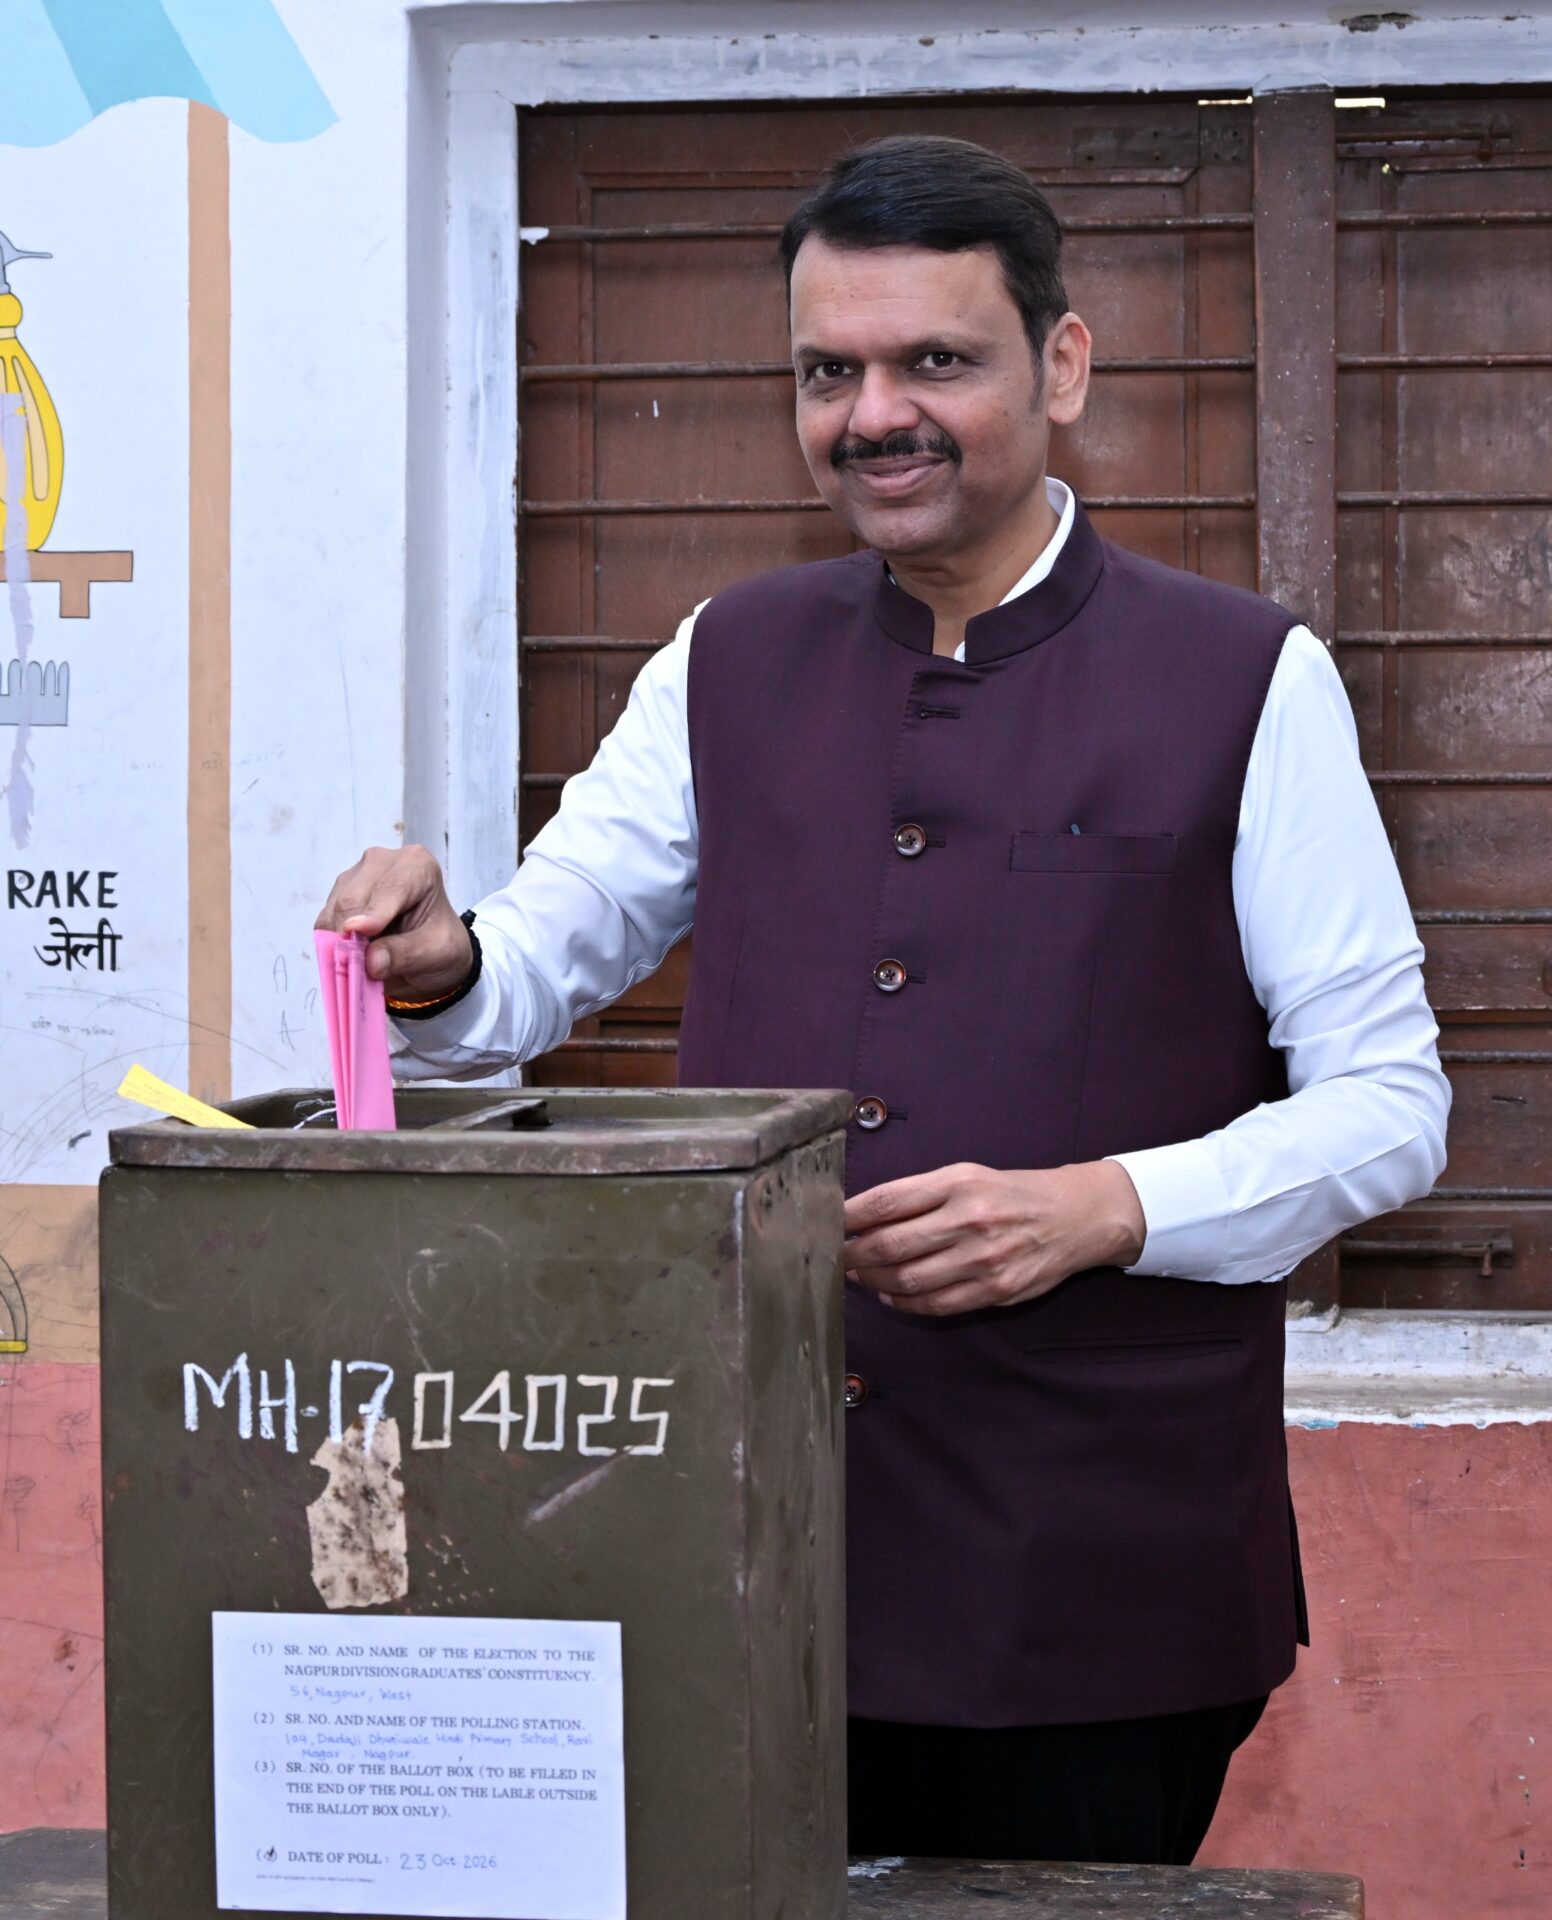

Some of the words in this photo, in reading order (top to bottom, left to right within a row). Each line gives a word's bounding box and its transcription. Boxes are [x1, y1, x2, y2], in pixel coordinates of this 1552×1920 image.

[7, 869, 119, 909] RAKE
[411, 1370, 675, 1456] 04025
[252, 1643, 273, 1656] (1)
[283, 1645, 303, 1656] SR.
[308, 1645, 330, 1657] NO.
[336, 1646, 364, 1657] AND
[369, 1646, 408, 1658] NAME
[418, 1647, 437, 1659] OF
[442, 1648, 468, 1659] THE
[473, 1649, 537, 1660] ELECTION
[543, 1649, 562, 1661] TO
[568, 1650, 595, 1661] THE
[253, 1712, 275, 1725] (2)
[285, 1713, 304, 1725] SR.
[308, 1714, 330, 1725] NO.
[334, 1715, 364, 1726] AND
[366, 1715, 406, 1727] NAME
[409, 1716, 427, 1727] OF
[430, 1717, 458, 1728] THE
[461, 1717, 519, 1729] POLLING
[522, 1719, 585, 1731] STATION.
[255, 1761, 276, 1774] (3)
[286, 1762, 306, 1774] SR.
[310, 1762, 333, 1774] NO.
[337, 1763, 355, 1775] OF
[359, 1764, 386, 1775] THE
[390, 1765, 442, 1777] BALLOT
[447, 1766, 474, 1778] BOX
[509, 1767, 526, 1778] BE
[530, 1768, 577, 1780] FILLED
[582, 1769, 597, 1780] IN
[286, 1782, 313, 1794] THE
[317, 1783, 344, 1794] END
[348, 1784, 366, 1795] OF
[369, 1785, 396, 1796] THE
[400, 1785, 434, 1797] POLL
[437, 1786, 457, 1797] ON
[461, 1787, 488, 1798] THE
[492, 1787, 536, 1799] LABLE
[539, 1789, 597, 1801] OUTSIDE
[287, 1802, 313, 1814] THE
[317, 1803, 369, 1815] BALLOT
[372, 1805, 399, 1816] BOX
[288, 1851, 324, 1863] DATE
[326, 1852, 345, 1863] OF
